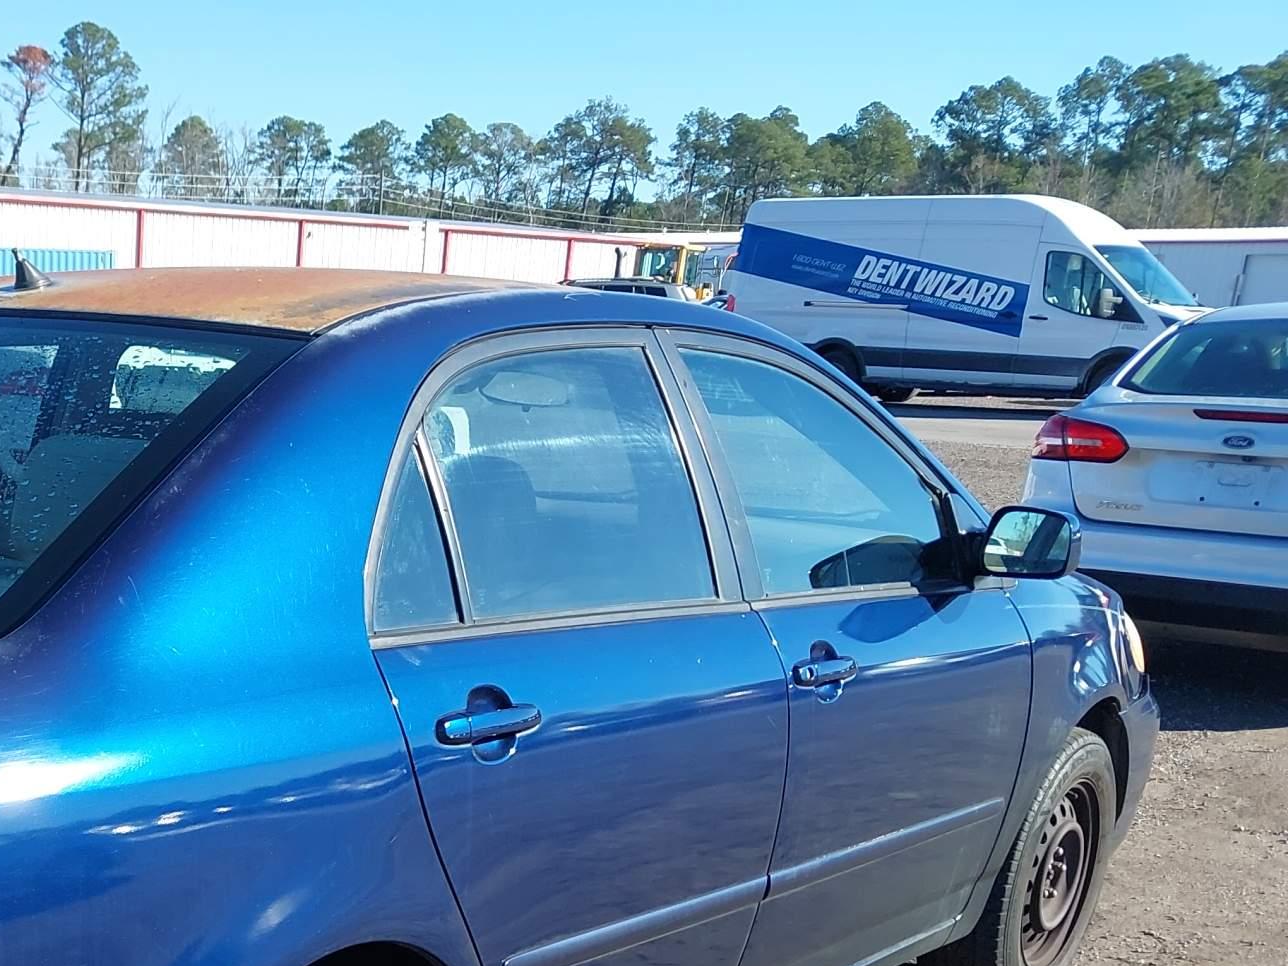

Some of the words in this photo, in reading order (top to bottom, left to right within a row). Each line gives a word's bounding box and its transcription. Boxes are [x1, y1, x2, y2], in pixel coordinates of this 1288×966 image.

[850, 278, 862, 286] THE
[861, 280, 882, 292] WORLD
[881, 284, 906, 297] LEADER
[904, 290, 913, 299] IN
[912, 292, 949, 307] AUTOMOTIVE
[947, 301, 999, 319] RECONDITIONING
